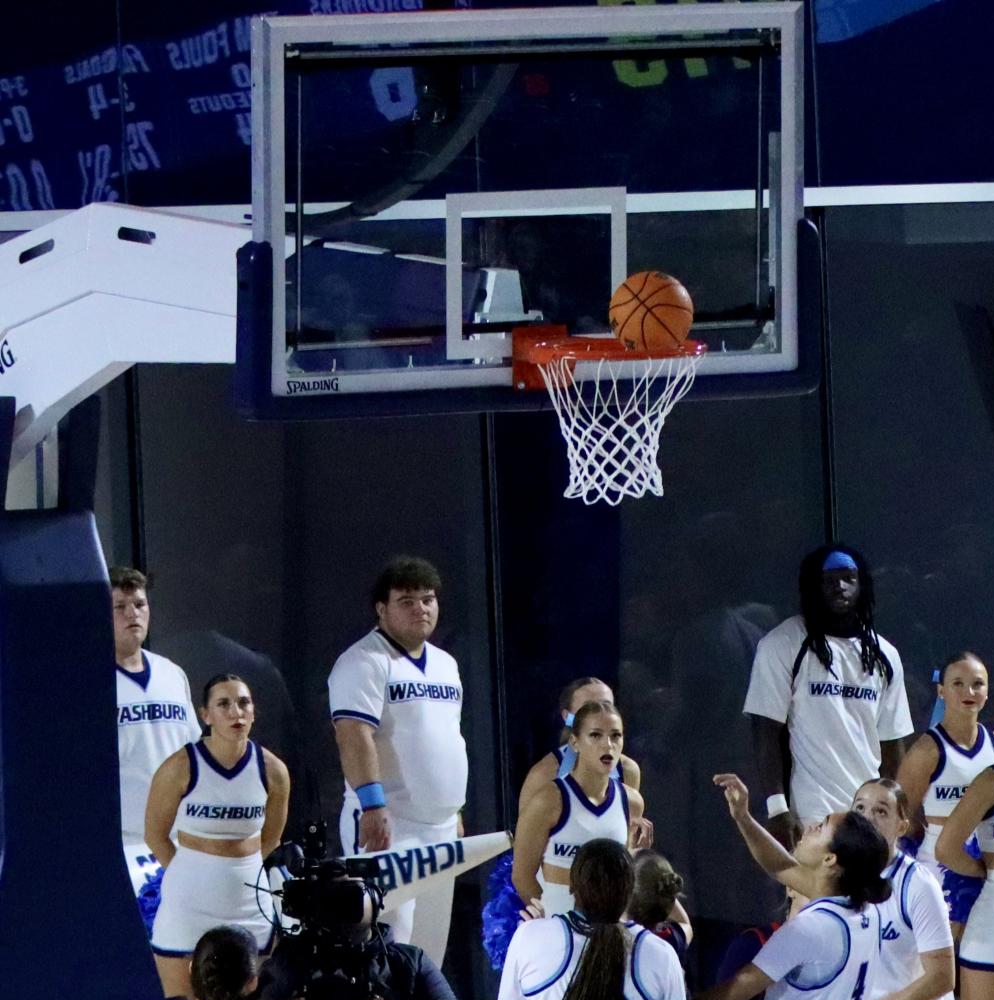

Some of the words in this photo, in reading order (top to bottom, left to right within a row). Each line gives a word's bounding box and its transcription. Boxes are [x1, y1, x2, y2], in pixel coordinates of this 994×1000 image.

[286, 377, 339, 395] SPALDING
[810, 683, 879, 701] WASHBURN
[118, 703, 188, 724] ASHBURN
